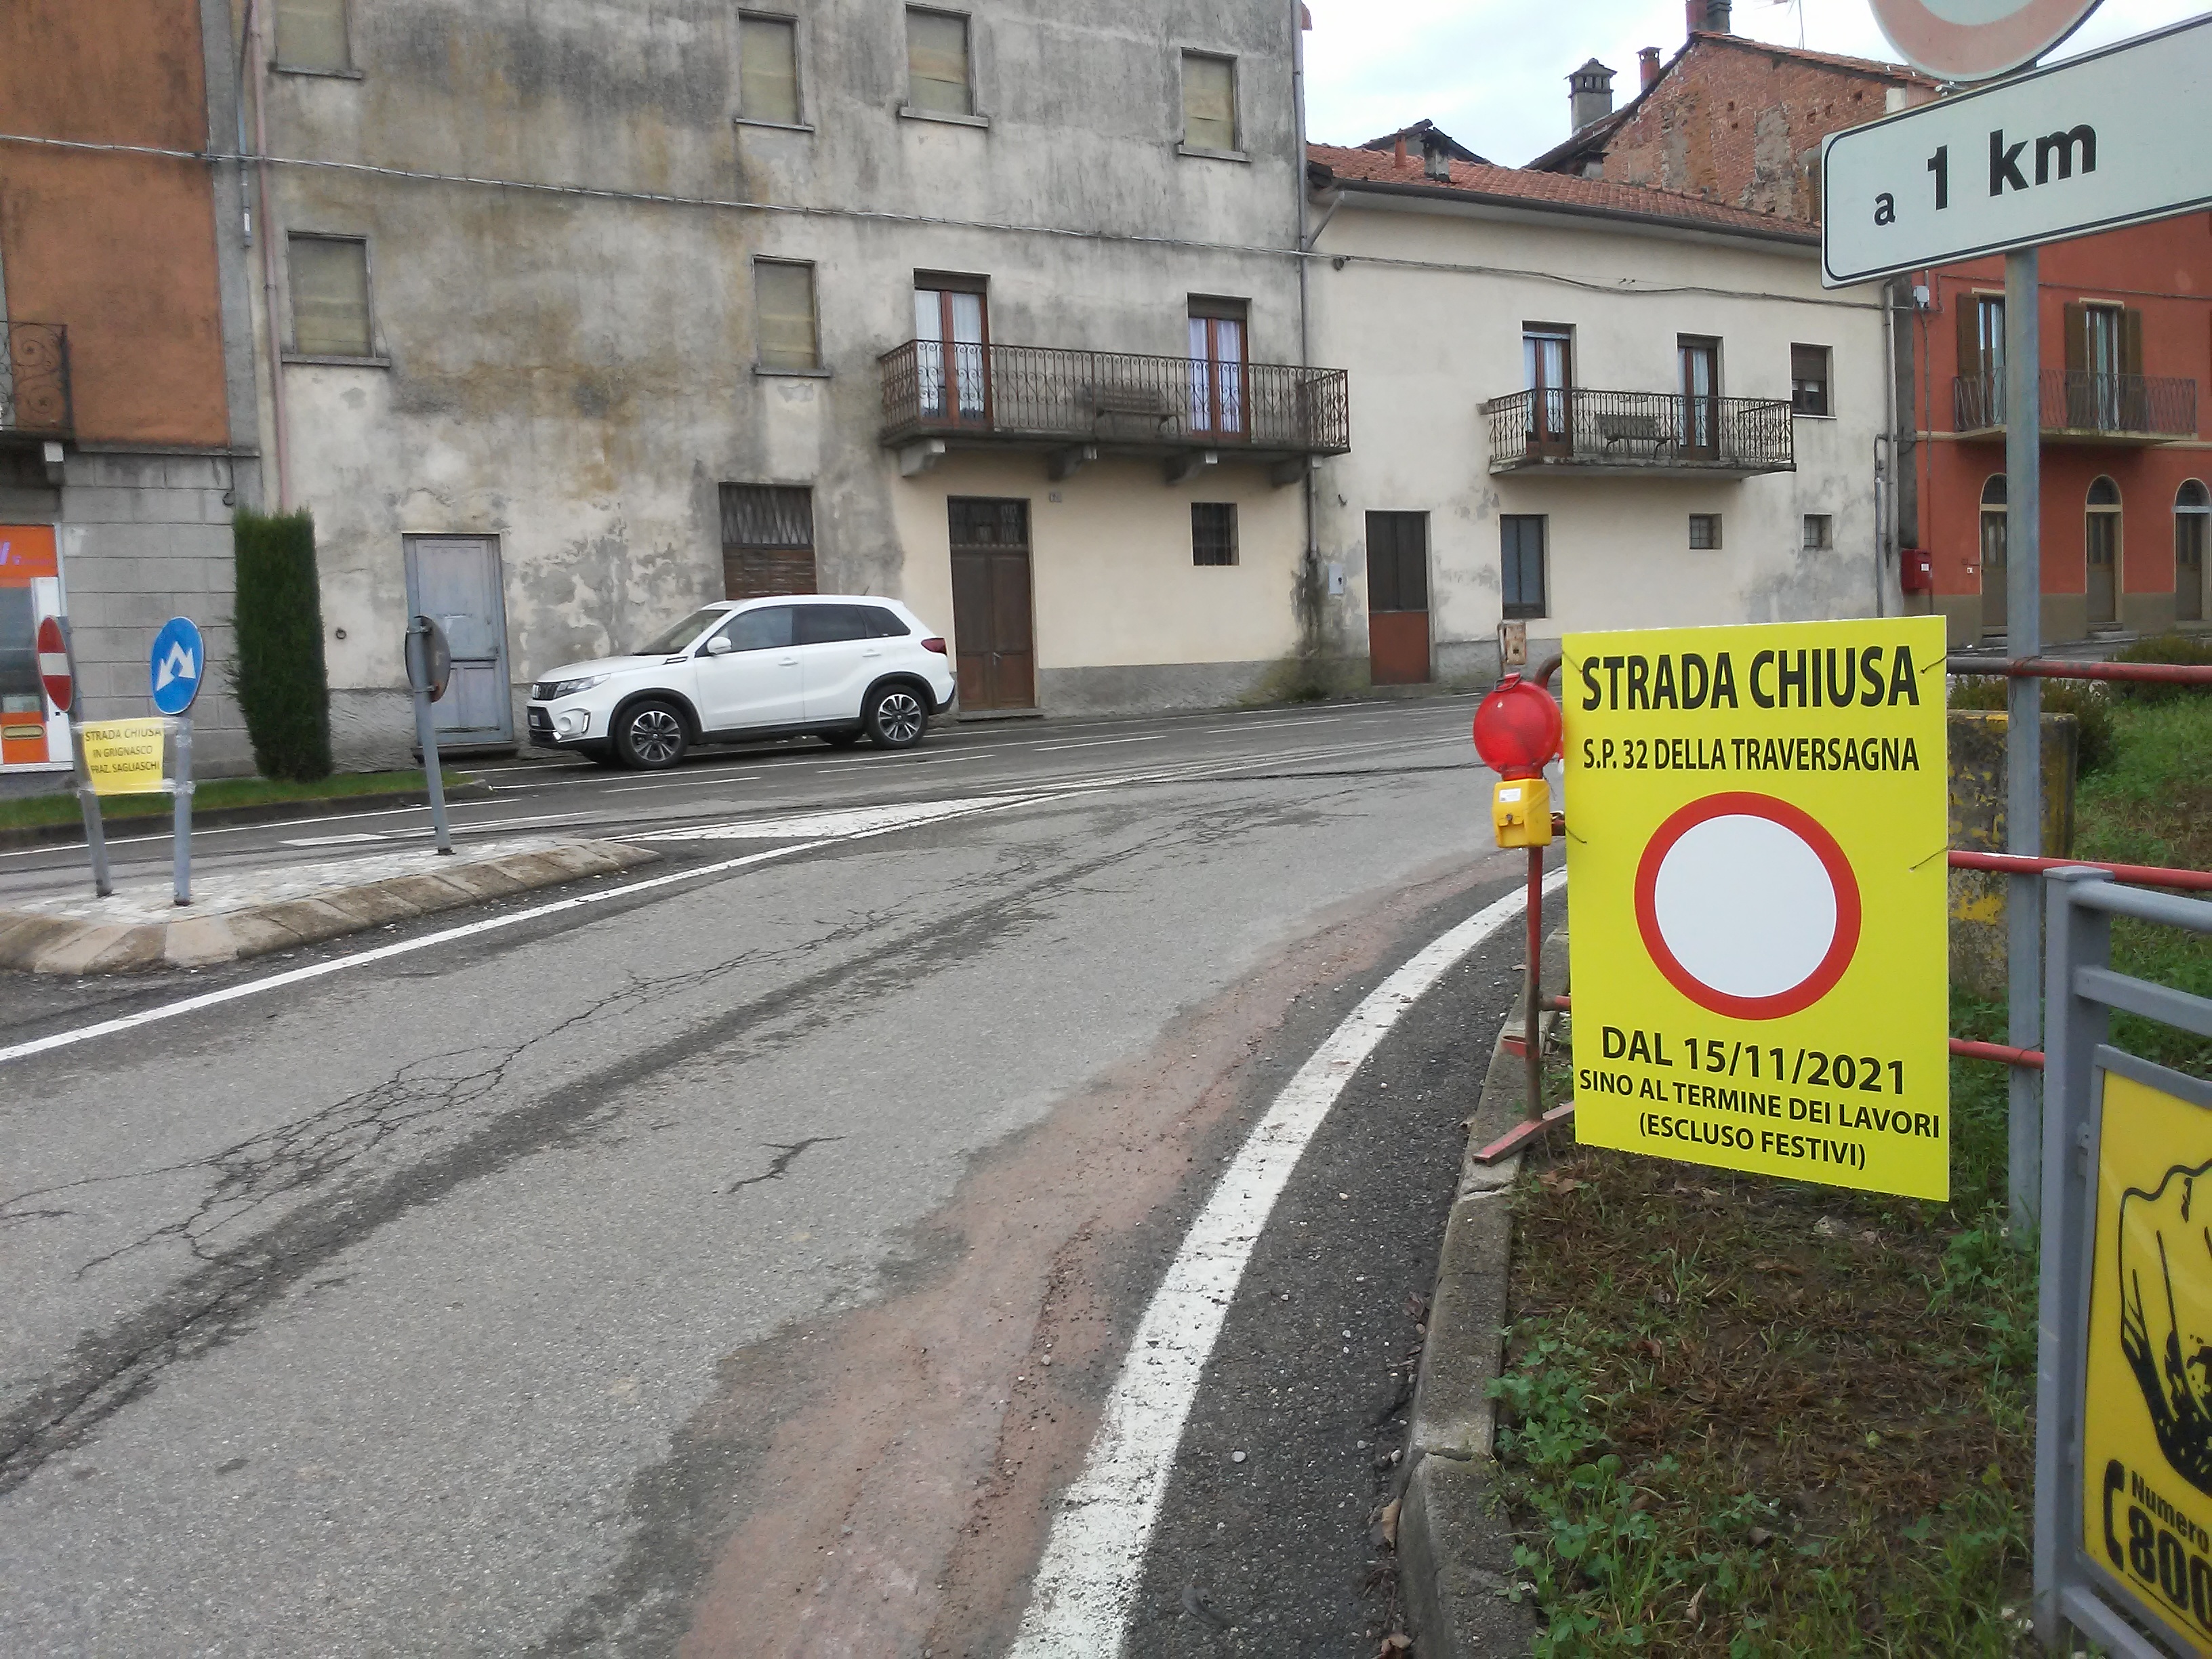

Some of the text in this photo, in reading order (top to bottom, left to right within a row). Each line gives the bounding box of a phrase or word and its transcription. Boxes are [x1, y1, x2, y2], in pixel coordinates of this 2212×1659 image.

[1873, 123, 2097, 226] a 1 km
[1581, 645, 1920, 711] STRADA CHIUSA
[85, 727, 161, 741] STRADA CHIUSA
[92, 745, 153, 759] IN GRIGNASCO
[112, 760, 160, 773] SAGLIASCHI
[1582, 737, 1921, 772] S.P. 32 DELLA TRAVERSAGNA
[1601, 1025, 1904, 1096] DAL 15/11/2021
[1579, 1068, 1940, 1139] SINO AL TERMINE DEI LAVORI
[1639, 1111, 1866, 1172] (ESCLUSO FESTIVI)
[2131, 1469, 2210, 1555] Numero
[2127, 1504, 2212, 1635] 800
